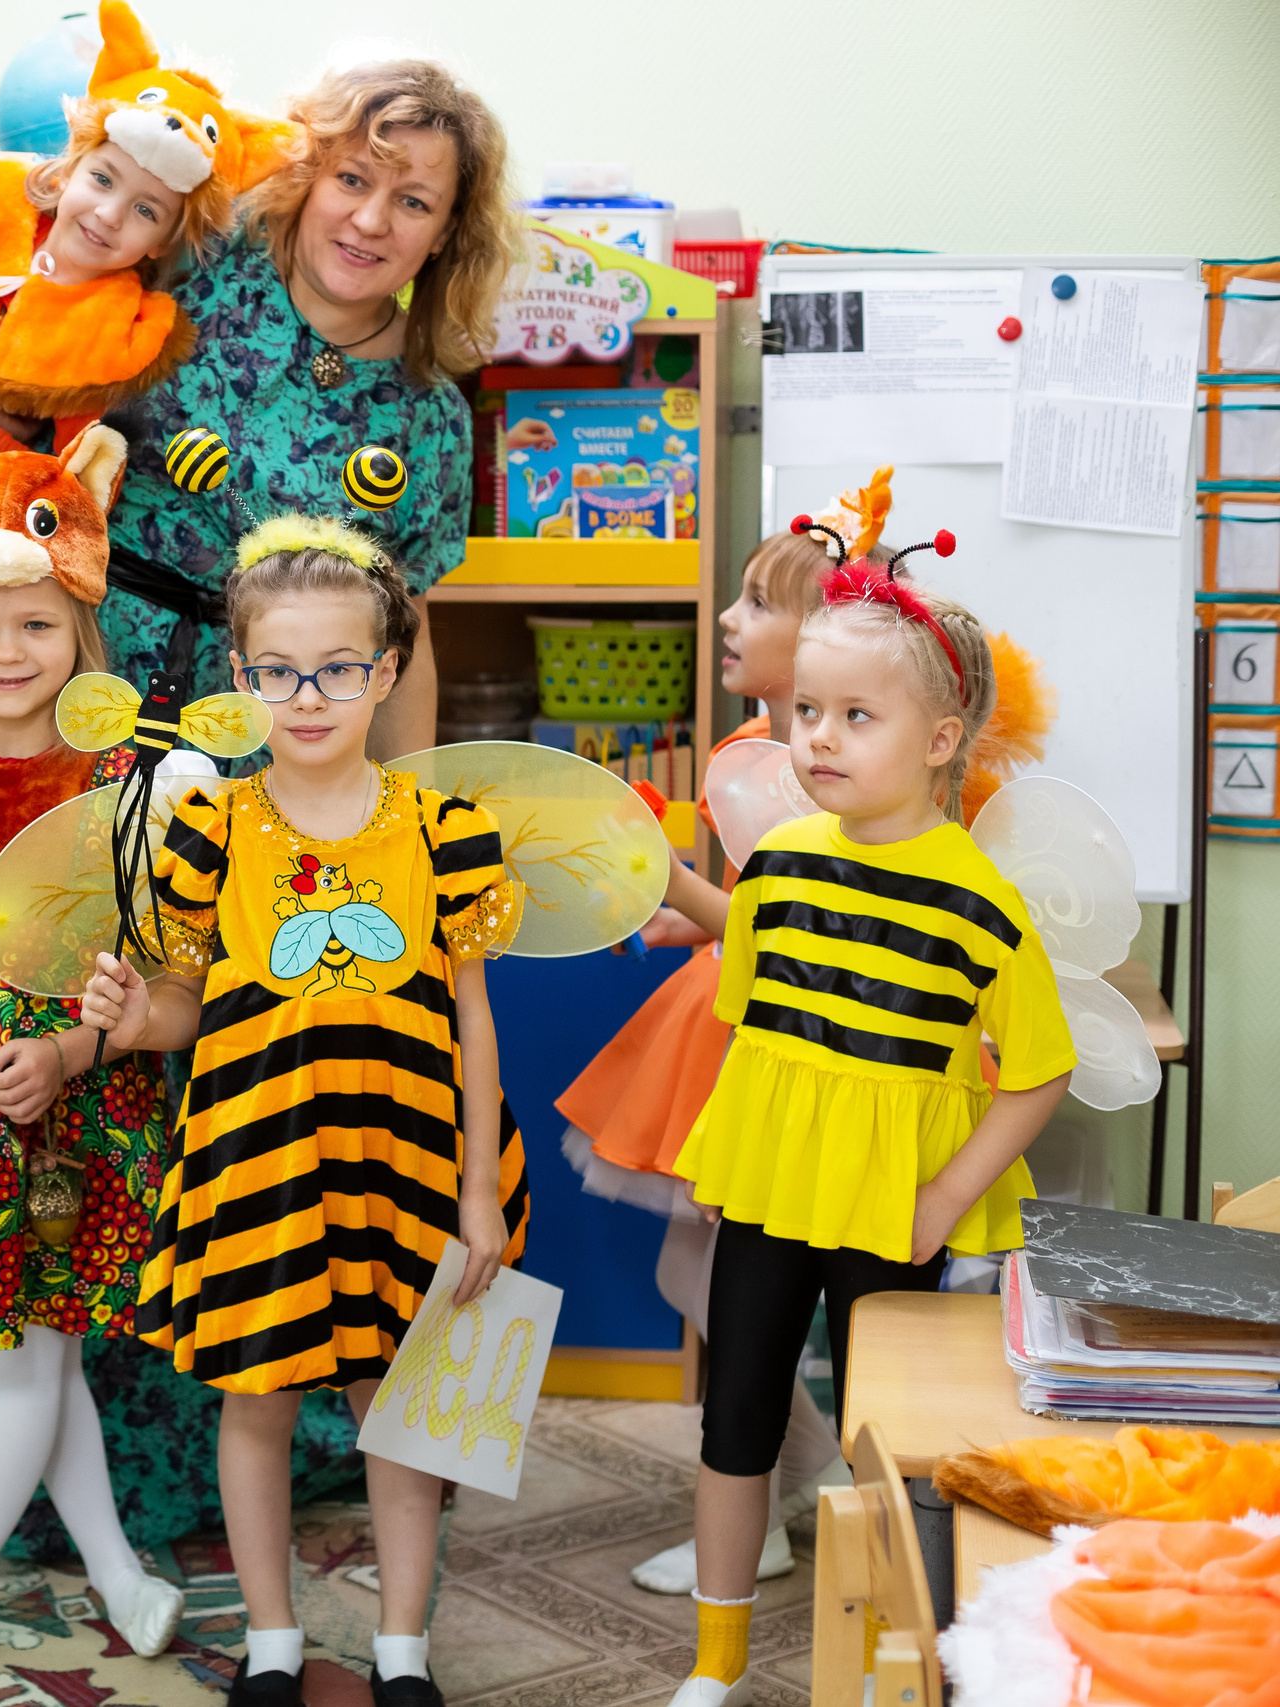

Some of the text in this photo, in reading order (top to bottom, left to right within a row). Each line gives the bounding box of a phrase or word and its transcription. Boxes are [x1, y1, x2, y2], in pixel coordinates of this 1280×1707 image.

[619, 277, 638, 302] 5
[516, 305, 577, 321] УГОЛОК
[521, 323, 567, 350] 7 8
[601, 323, 620, 350] 9
[572, 426, 634, 440] СЧИТАЕМ
[578, 442, 628, 456] ВМЕСТЕ
[1232, 642, 1259, 683] 6
